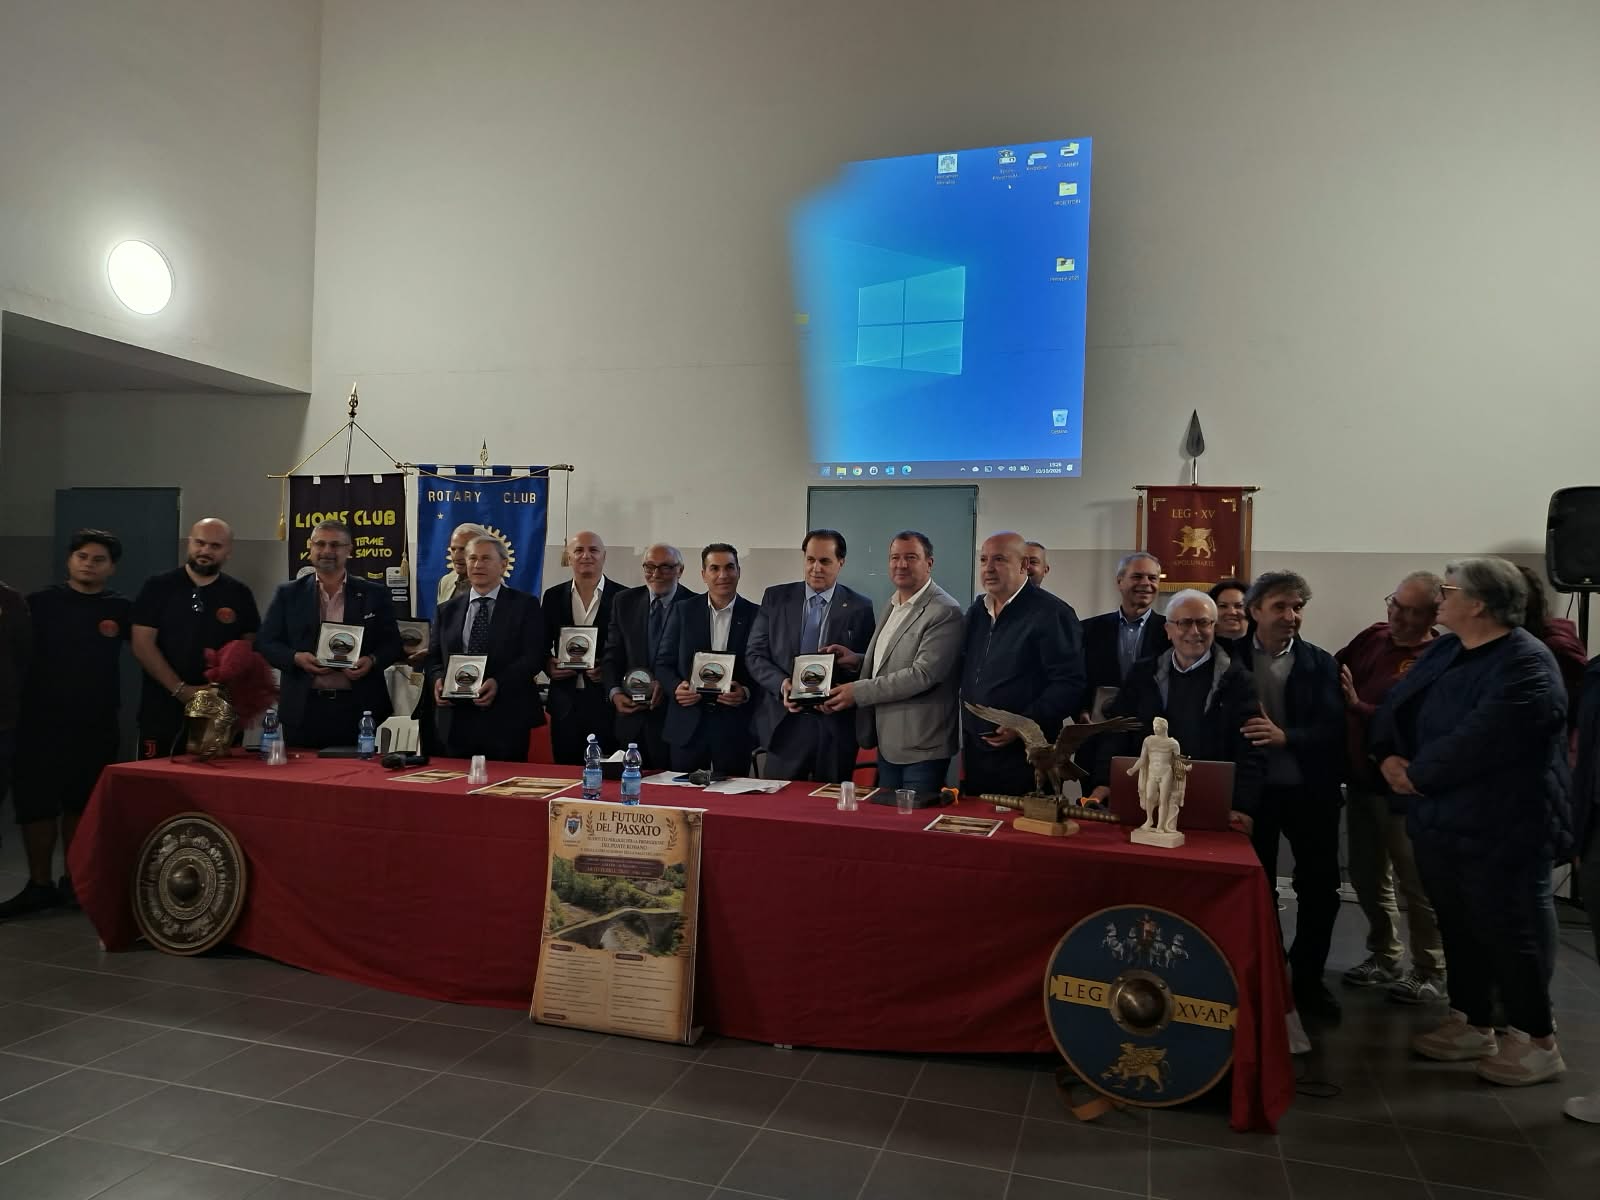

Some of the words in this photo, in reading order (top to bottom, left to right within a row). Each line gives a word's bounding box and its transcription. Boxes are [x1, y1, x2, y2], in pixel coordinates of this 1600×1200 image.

[428, 491, 482, 503] ROTARY
[503, 492, 536, 504] CLUB
[353, 509, 396, 526] CLUB
[1172, 508, 1192, 519] LEG
[1200, 509, 1216, 519] XV
[354, 536, 385, 547] TERME
[355, 548, 392, 558] SAVUTO
[599, 812, 607, 821] IL
[611, 811, 654, 824] FUTURO
[596, 823, 612, 832] DEL
[616, 823, 661, 836] PASSATO
[1064, 982, 1103, 1001] LEG
